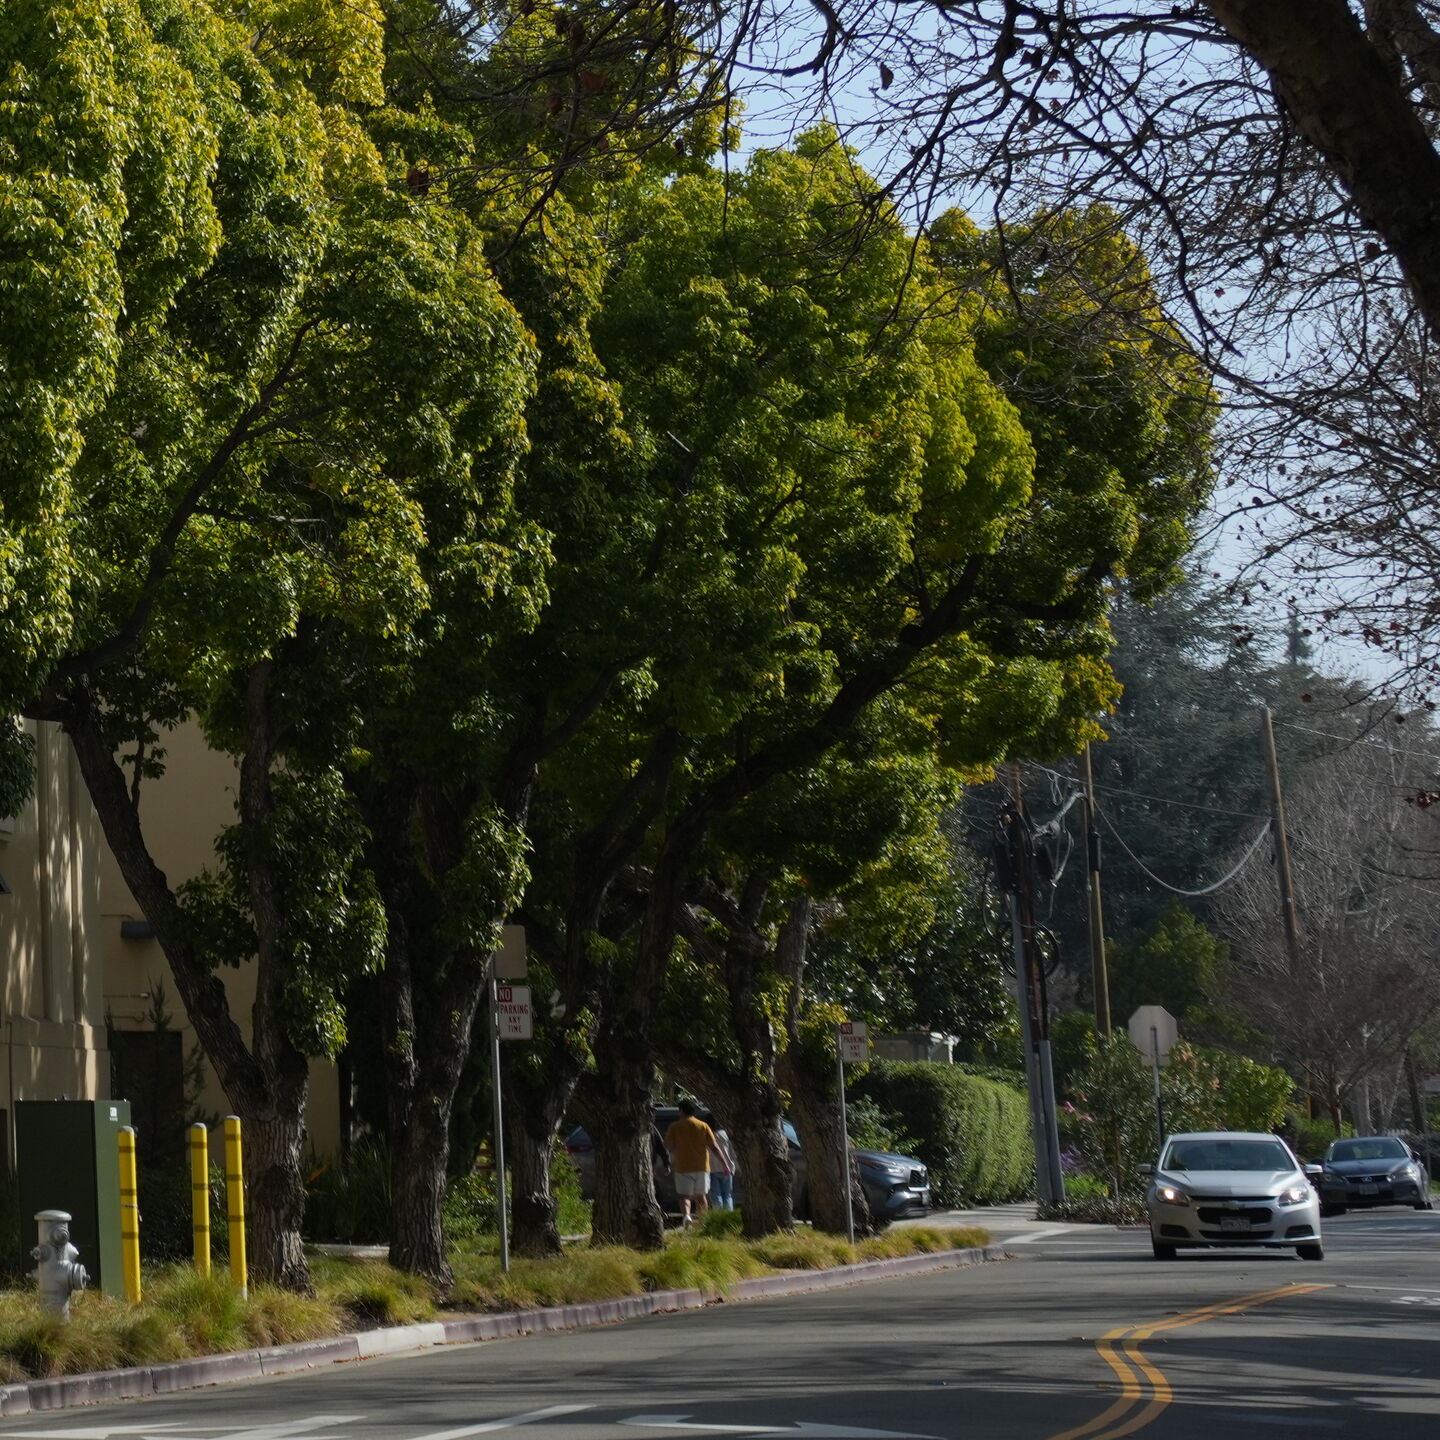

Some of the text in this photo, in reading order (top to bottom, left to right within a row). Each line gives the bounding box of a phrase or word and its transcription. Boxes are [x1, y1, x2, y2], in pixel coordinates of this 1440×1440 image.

[499, 988, 511, 1001] NO
[500, 1004, 529, 1014] PARKING
[508, 1025, 522, 1033] TIME
